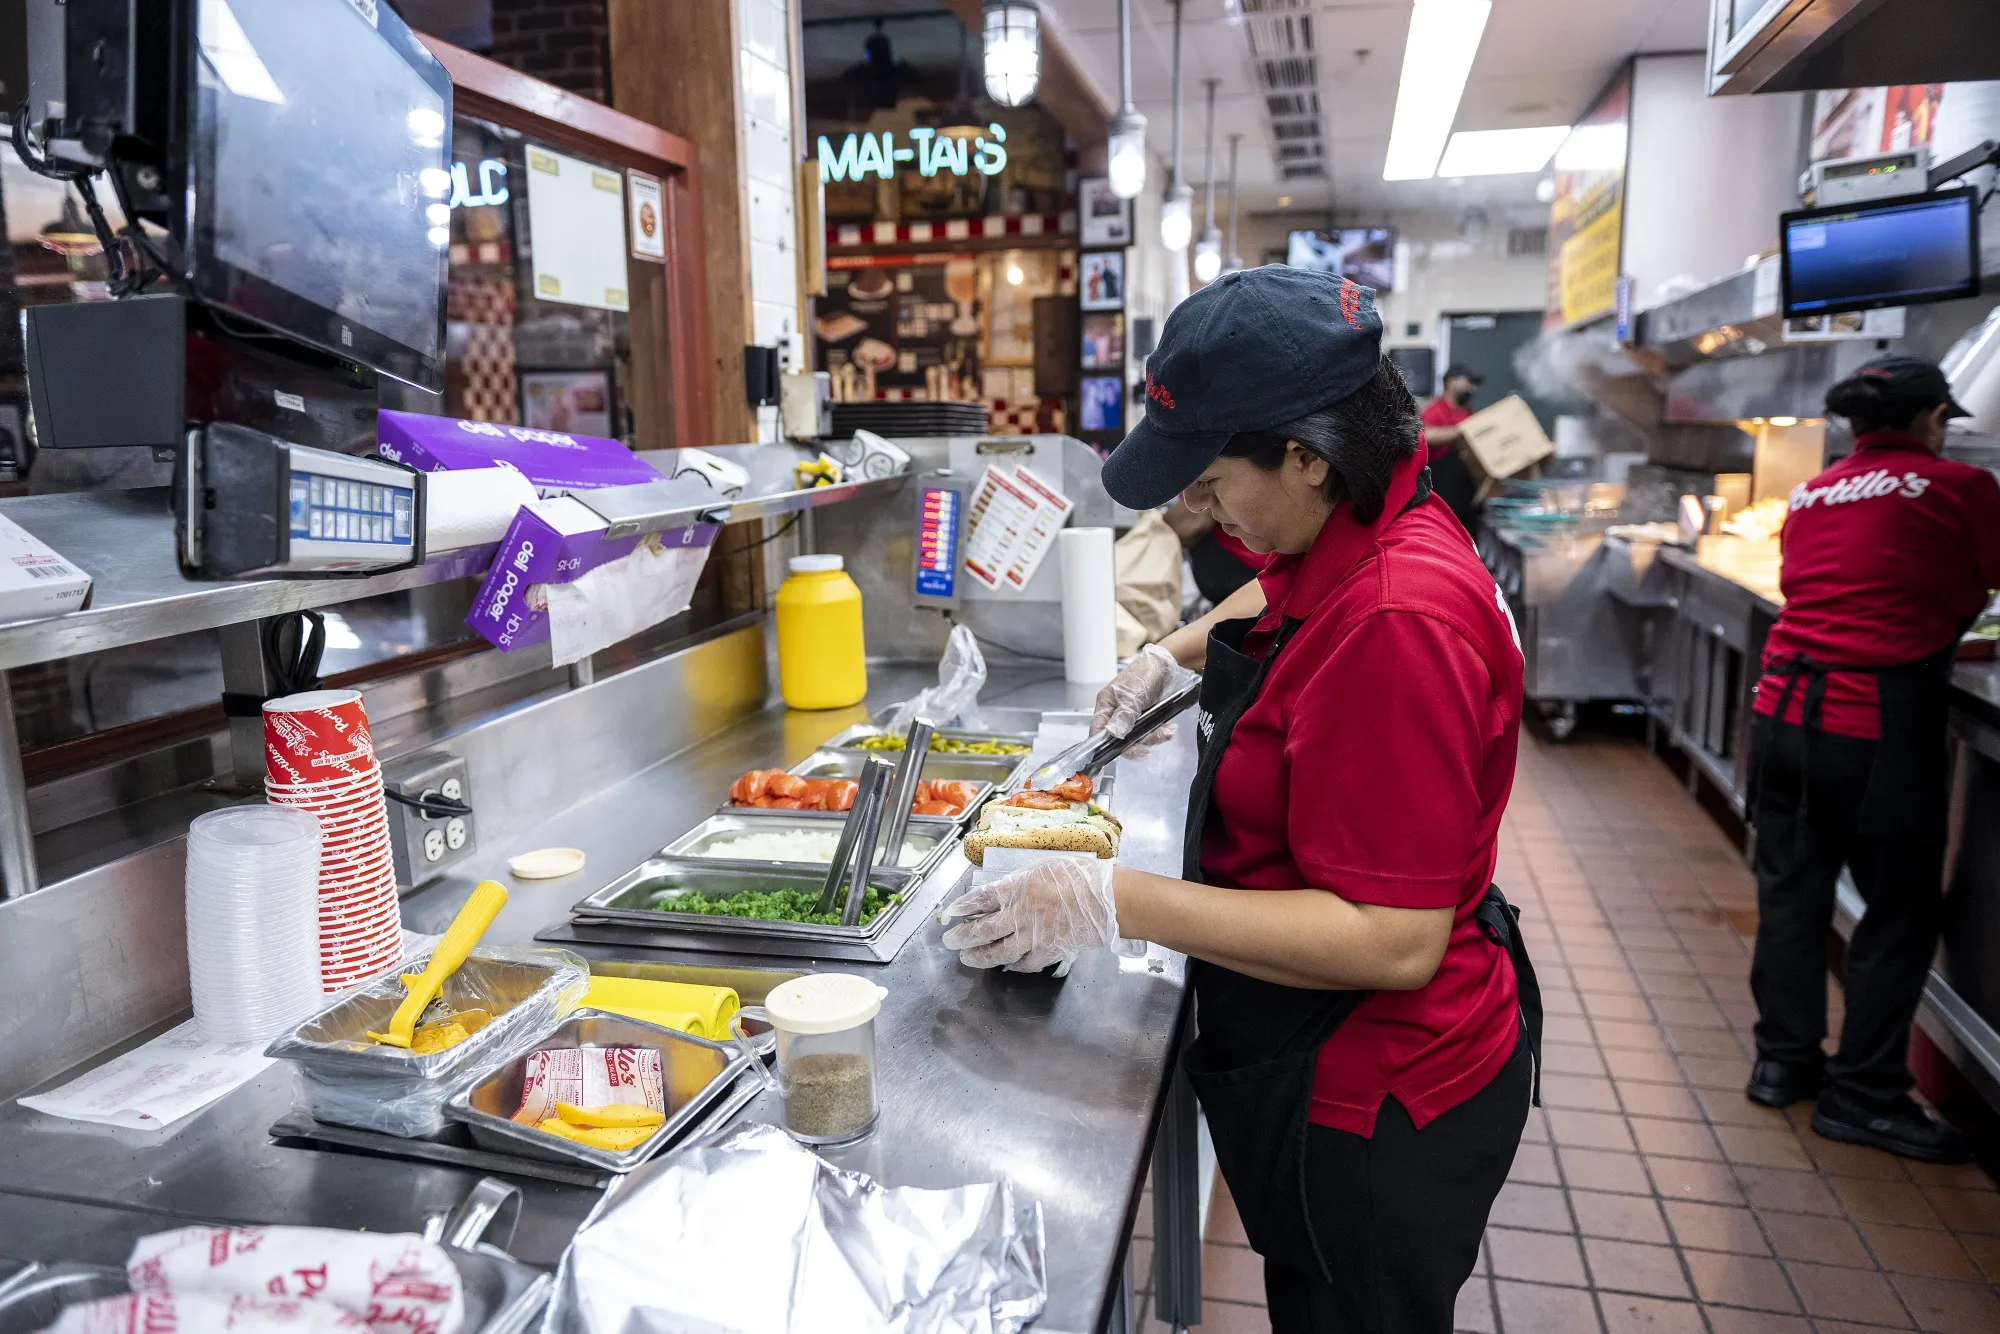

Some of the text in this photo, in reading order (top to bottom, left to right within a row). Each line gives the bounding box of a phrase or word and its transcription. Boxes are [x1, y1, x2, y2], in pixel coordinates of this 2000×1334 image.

[514, 540, 534, 572] deli
[557, 557, 582, 571] HD-15
[56, 588, 84, 600] 1201713
[490, 569, 519, 622] paper
[499, 613, 523, 646] HD-15
